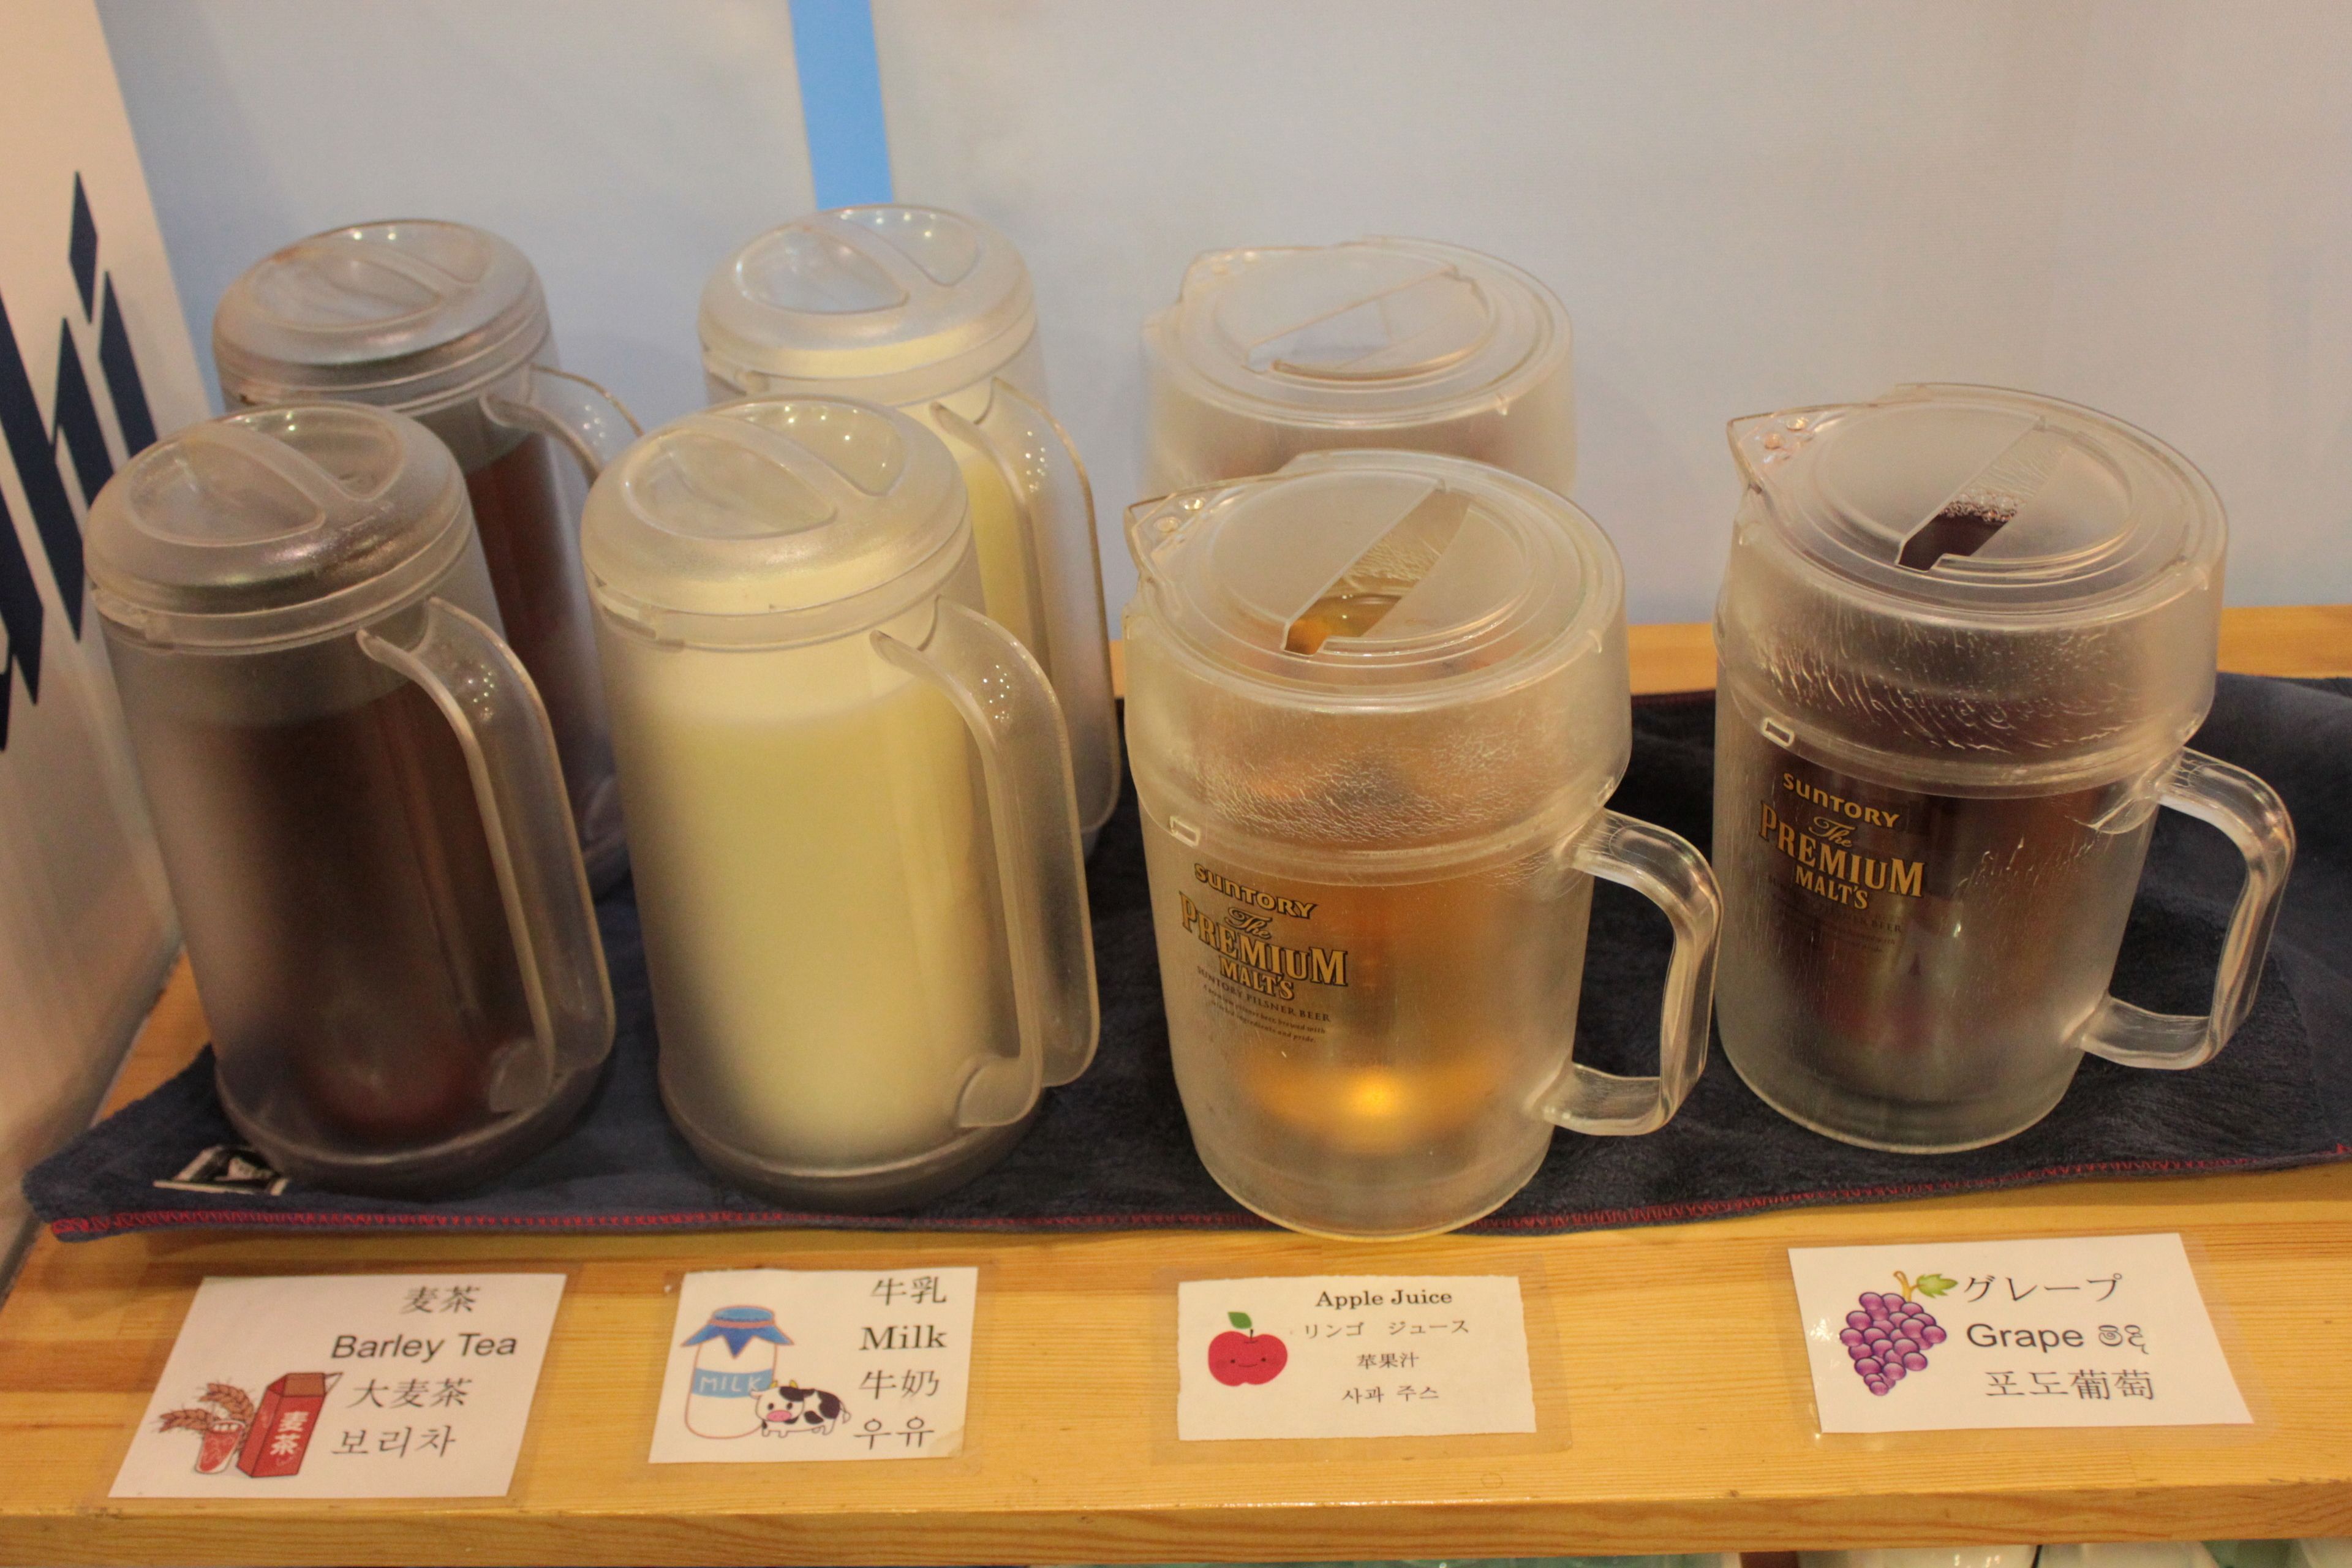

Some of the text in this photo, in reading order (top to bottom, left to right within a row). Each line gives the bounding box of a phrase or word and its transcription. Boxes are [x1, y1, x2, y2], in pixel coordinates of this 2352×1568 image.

[1782, 772, 1899, 827] SUNTORY
[1808, 816, 1855, 848] The
[1759, 801, 1926, 898] PREMIUM
[1194, 862, 1318, 919] SUNTORY
[1795, 865, 1868, 910] MALT'S
[1179, 890, 1348, 987] PREMIUM
[1225, 907, 1273, 940] The
[1219, 955, 1295, 1001] MALT'S
[1246, 993, 1297, 1016] PILSNER
[1299, 1009, 1331, 1022] BEER
[401, 1285, 480, 1314] 麦茶
[870, 1275, 947, 1306] 牛乳
[1315, 1289, 1452, 1311] Apple Juice
[1964, 1273, 2123, 1303] グレープ
[859, 1324, 948, 1351] Milk
[1305, 1319, 1469, 1339] リンゴ ジュース
[1966, 1323, 2084, 1354] Grape
[330, 1332, 518, 1363] Barley Tea
[1357, 1352, 1419, 1370] 苹果汁
[347, 1378, 473, 1408] 大麦茶
[698, 1374, 764, 1393] MILK
[859, 1369, 940, 1400] 牛奶
[1342, 1385, 1439, 1404] 사과 주스
[331, 1425, 456, 1458] 보리차
[854, 1417, 935, 1450] 우유
